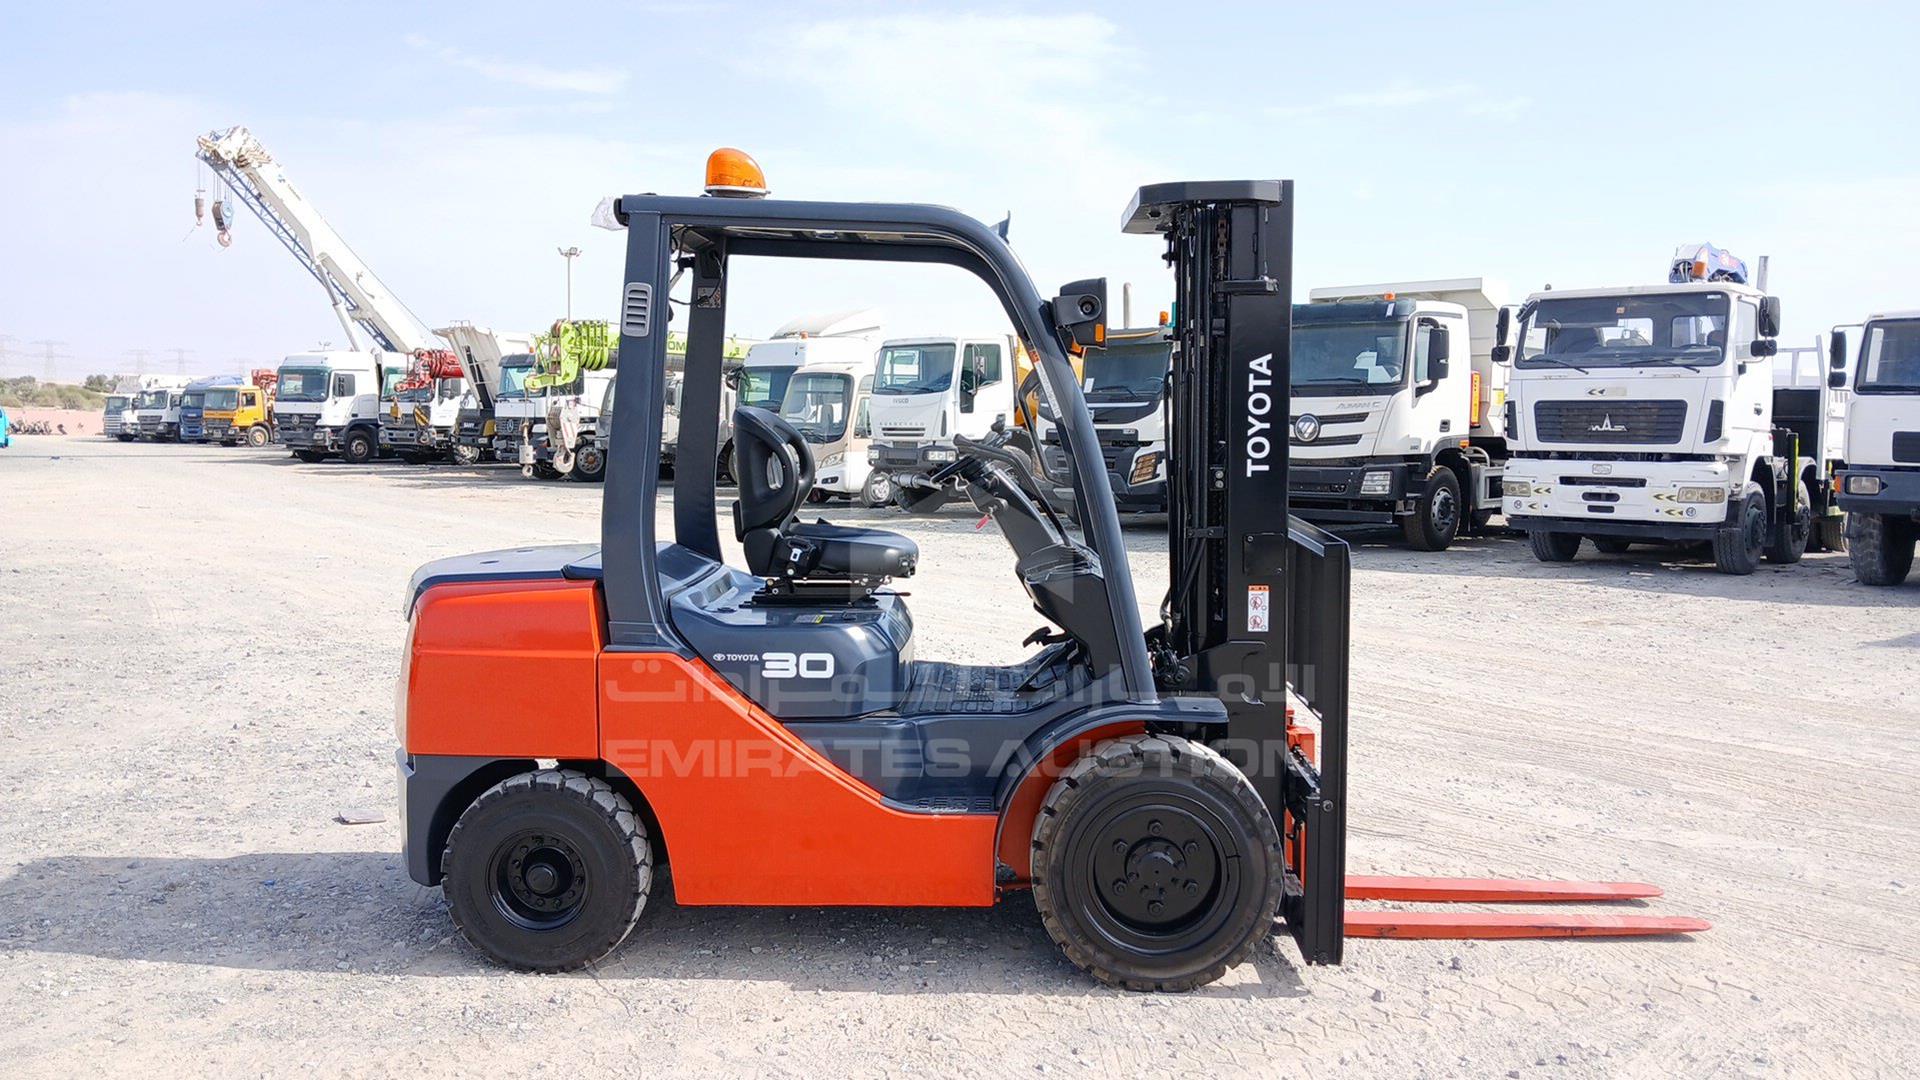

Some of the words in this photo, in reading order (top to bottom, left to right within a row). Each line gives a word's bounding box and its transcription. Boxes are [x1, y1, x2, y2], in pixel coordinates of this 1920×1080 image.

[1246, 353, 1273, 477] TOYOTA
[726, 654, 759, 662] TOYOTA
[762, 652, 835, 678] 30
